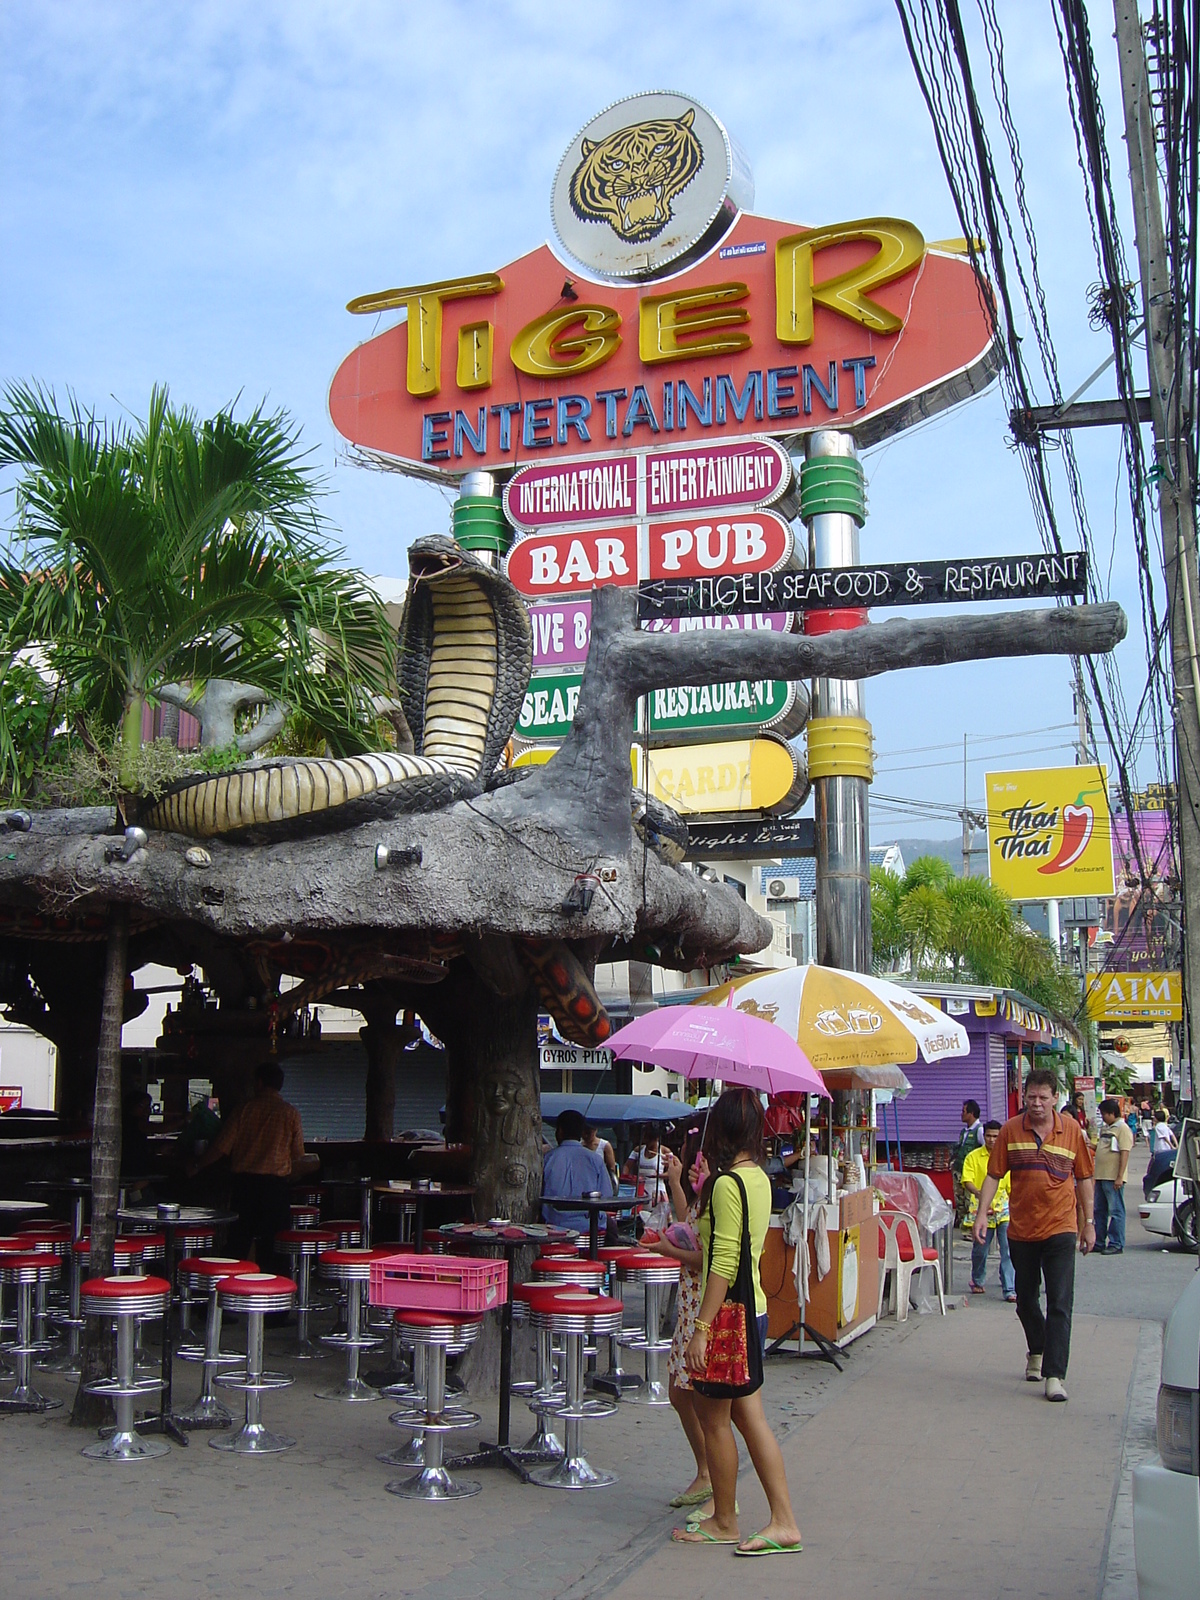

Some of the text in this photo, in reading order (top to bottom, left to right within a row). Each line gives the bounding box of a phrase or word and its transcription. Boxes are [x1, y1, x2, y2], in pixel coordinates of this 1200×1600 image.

[346, 217, 925, 397] TIGER
[421, 355, 877, 461] ENTERTAINMENT
[519, 456, 774, 513] INTERNATIONAL ENTERTAINMENT
[529, 523, 767, 585] BAR PUB
[696, 555, 1079, 609] TIGER SEAFOOD & RESTAURANT
[532, 612, 564, 656] IVE
[653, 678, 776, 719] RESTAURANT
[1001, 799, 1060, 832] Thai
[994, 829, 1053, 861] Thai
[1074, 865, 1105, 873] Restaurant
[1105, 978, 1171, 1001] ATM
[543, 1049, 608, 1064] GYROS PITA
